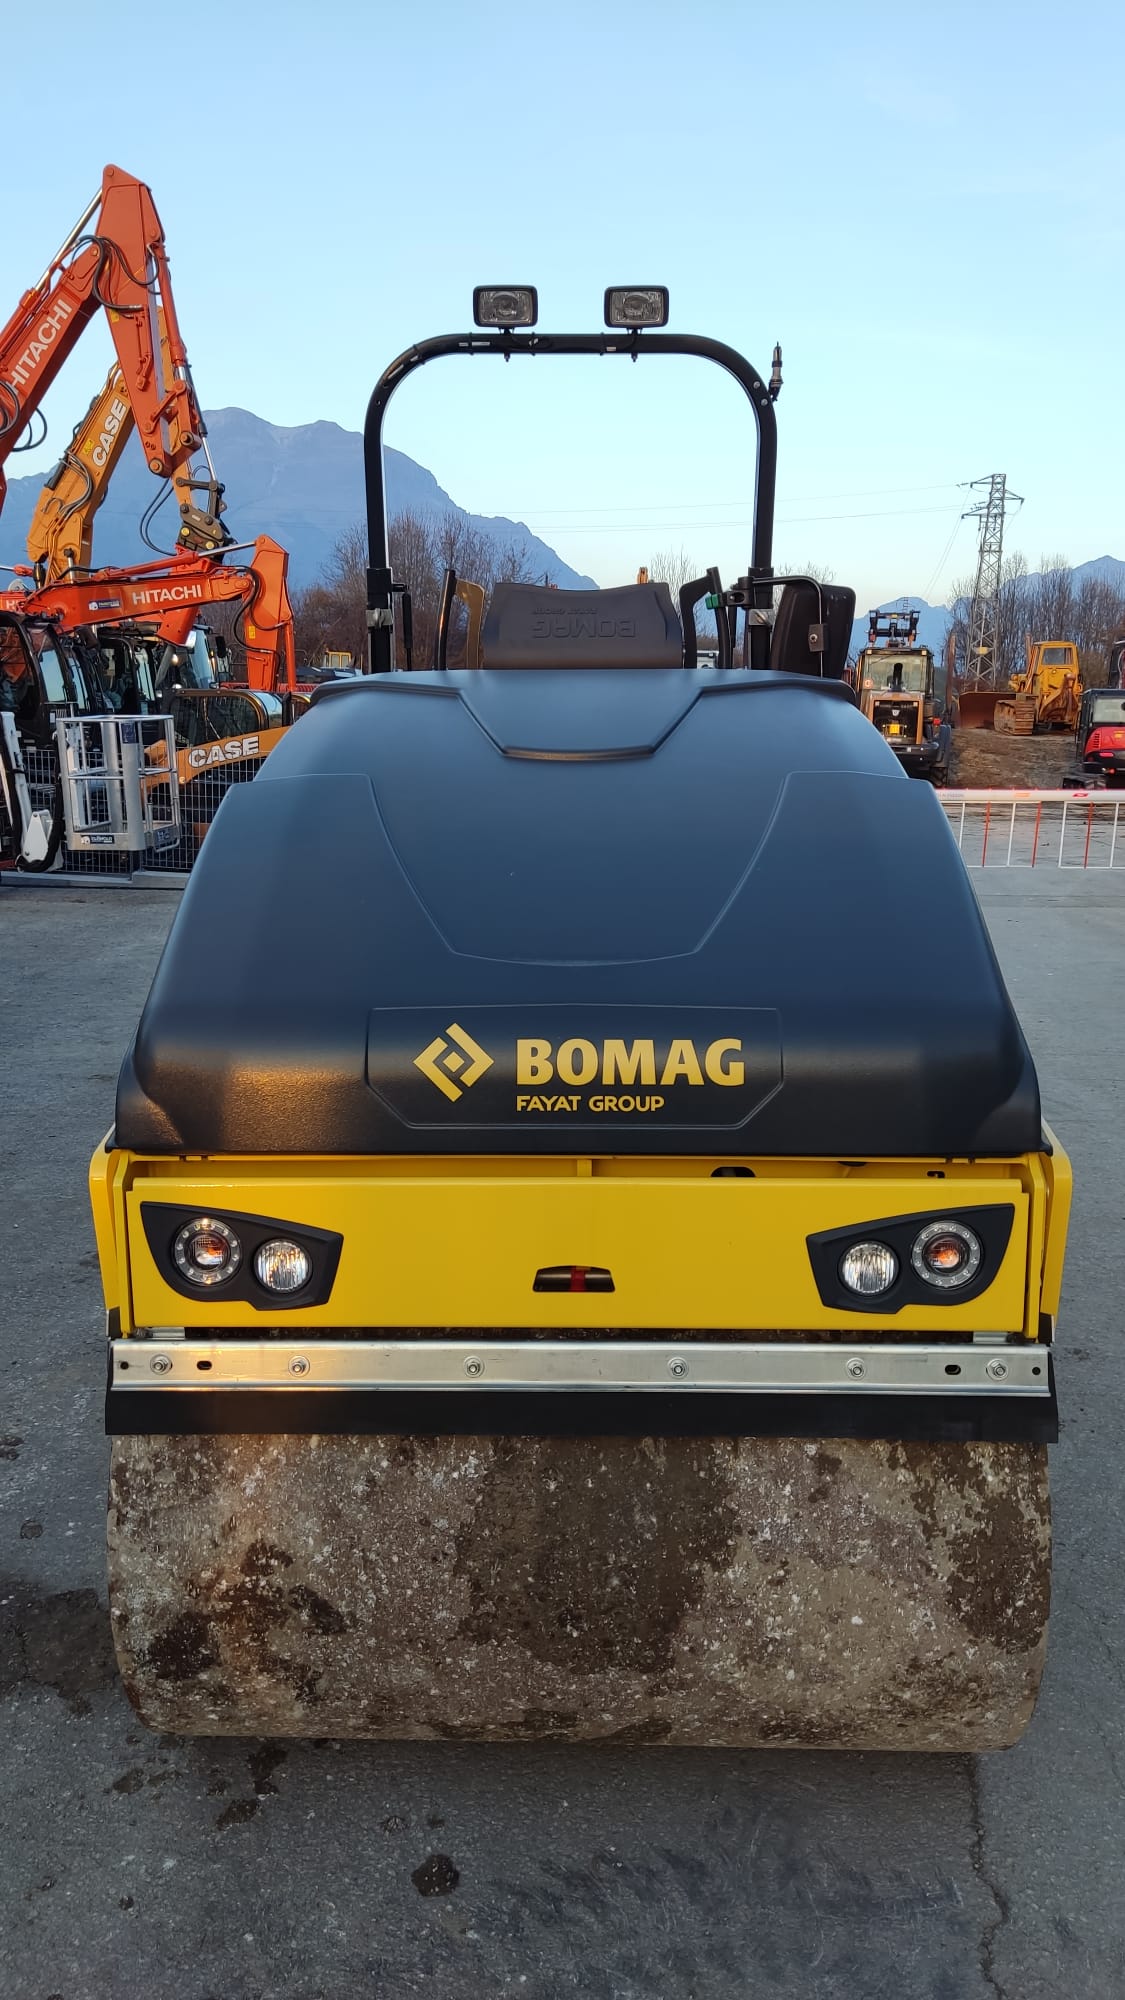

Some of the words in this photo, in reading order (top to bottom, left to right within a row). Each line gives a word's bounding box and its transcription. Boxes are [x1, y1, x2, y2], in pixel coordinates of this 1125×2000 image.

[7, 299, 72, 393] HITACHI
[92, 399, 127, 467] CASE
[133, 585, 202, 605] HITACHI
[531, 618, 637, 638] BOMAG
[190, 736, 259, 768] CASE
[516, 1038, 746, 1087] BOMAG
[516, 1096, 581, 1112] FAYAT
[589, 1096, 665, 1112] GROUP
